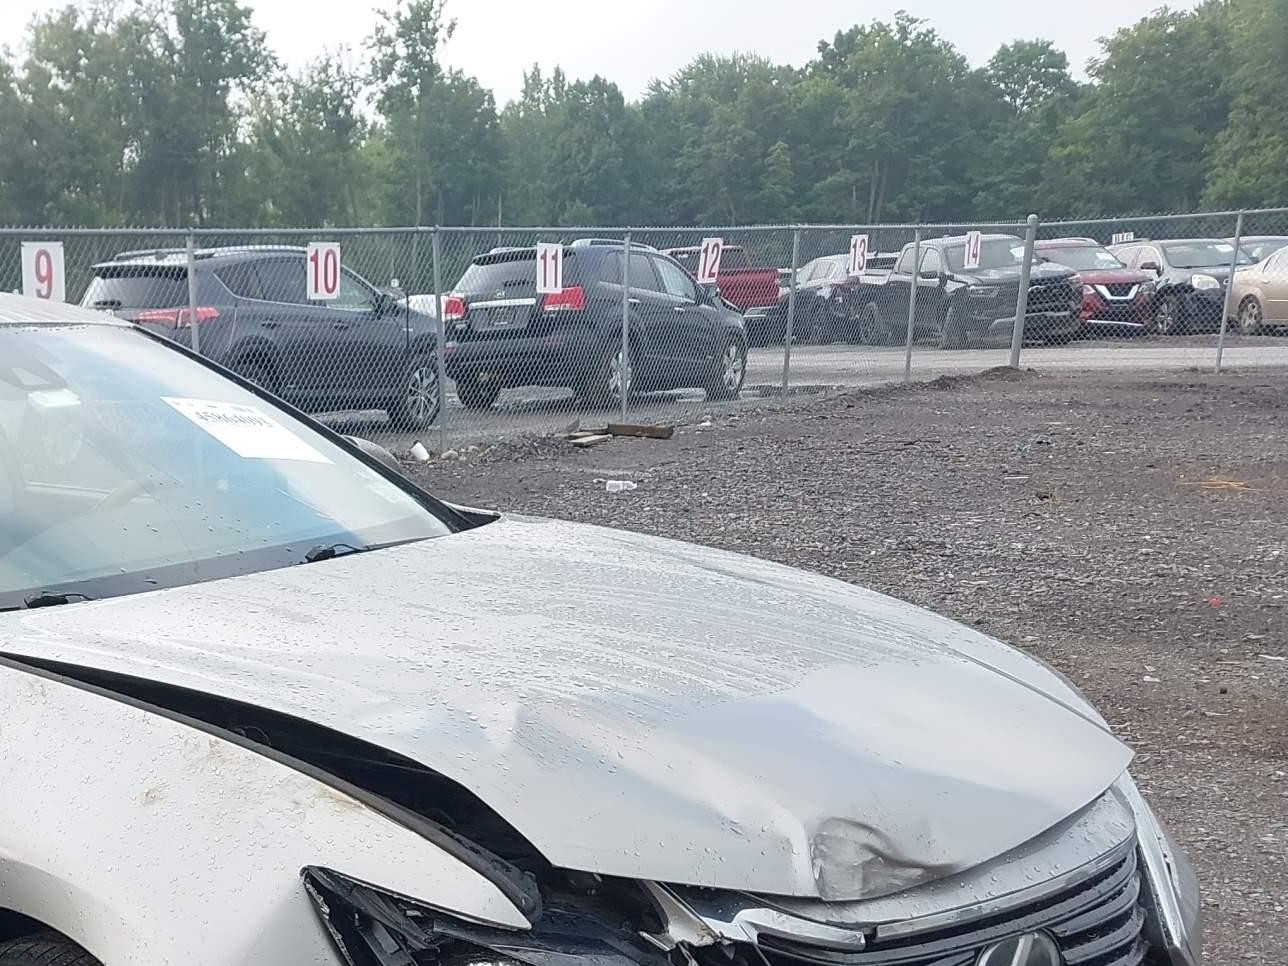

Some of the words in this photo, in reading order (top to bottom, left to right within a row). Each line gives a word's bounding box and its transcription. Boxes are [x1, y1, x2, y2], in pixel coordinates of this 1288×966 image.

[540, 248, 558, 289] 11
[702, 242, 720, 279] 12
[852, 238, 866, 271] 13
[967, 234, 980, 265] 14
[34, 249, 53, 300] 9
[310, 249, 338, 294] 10
